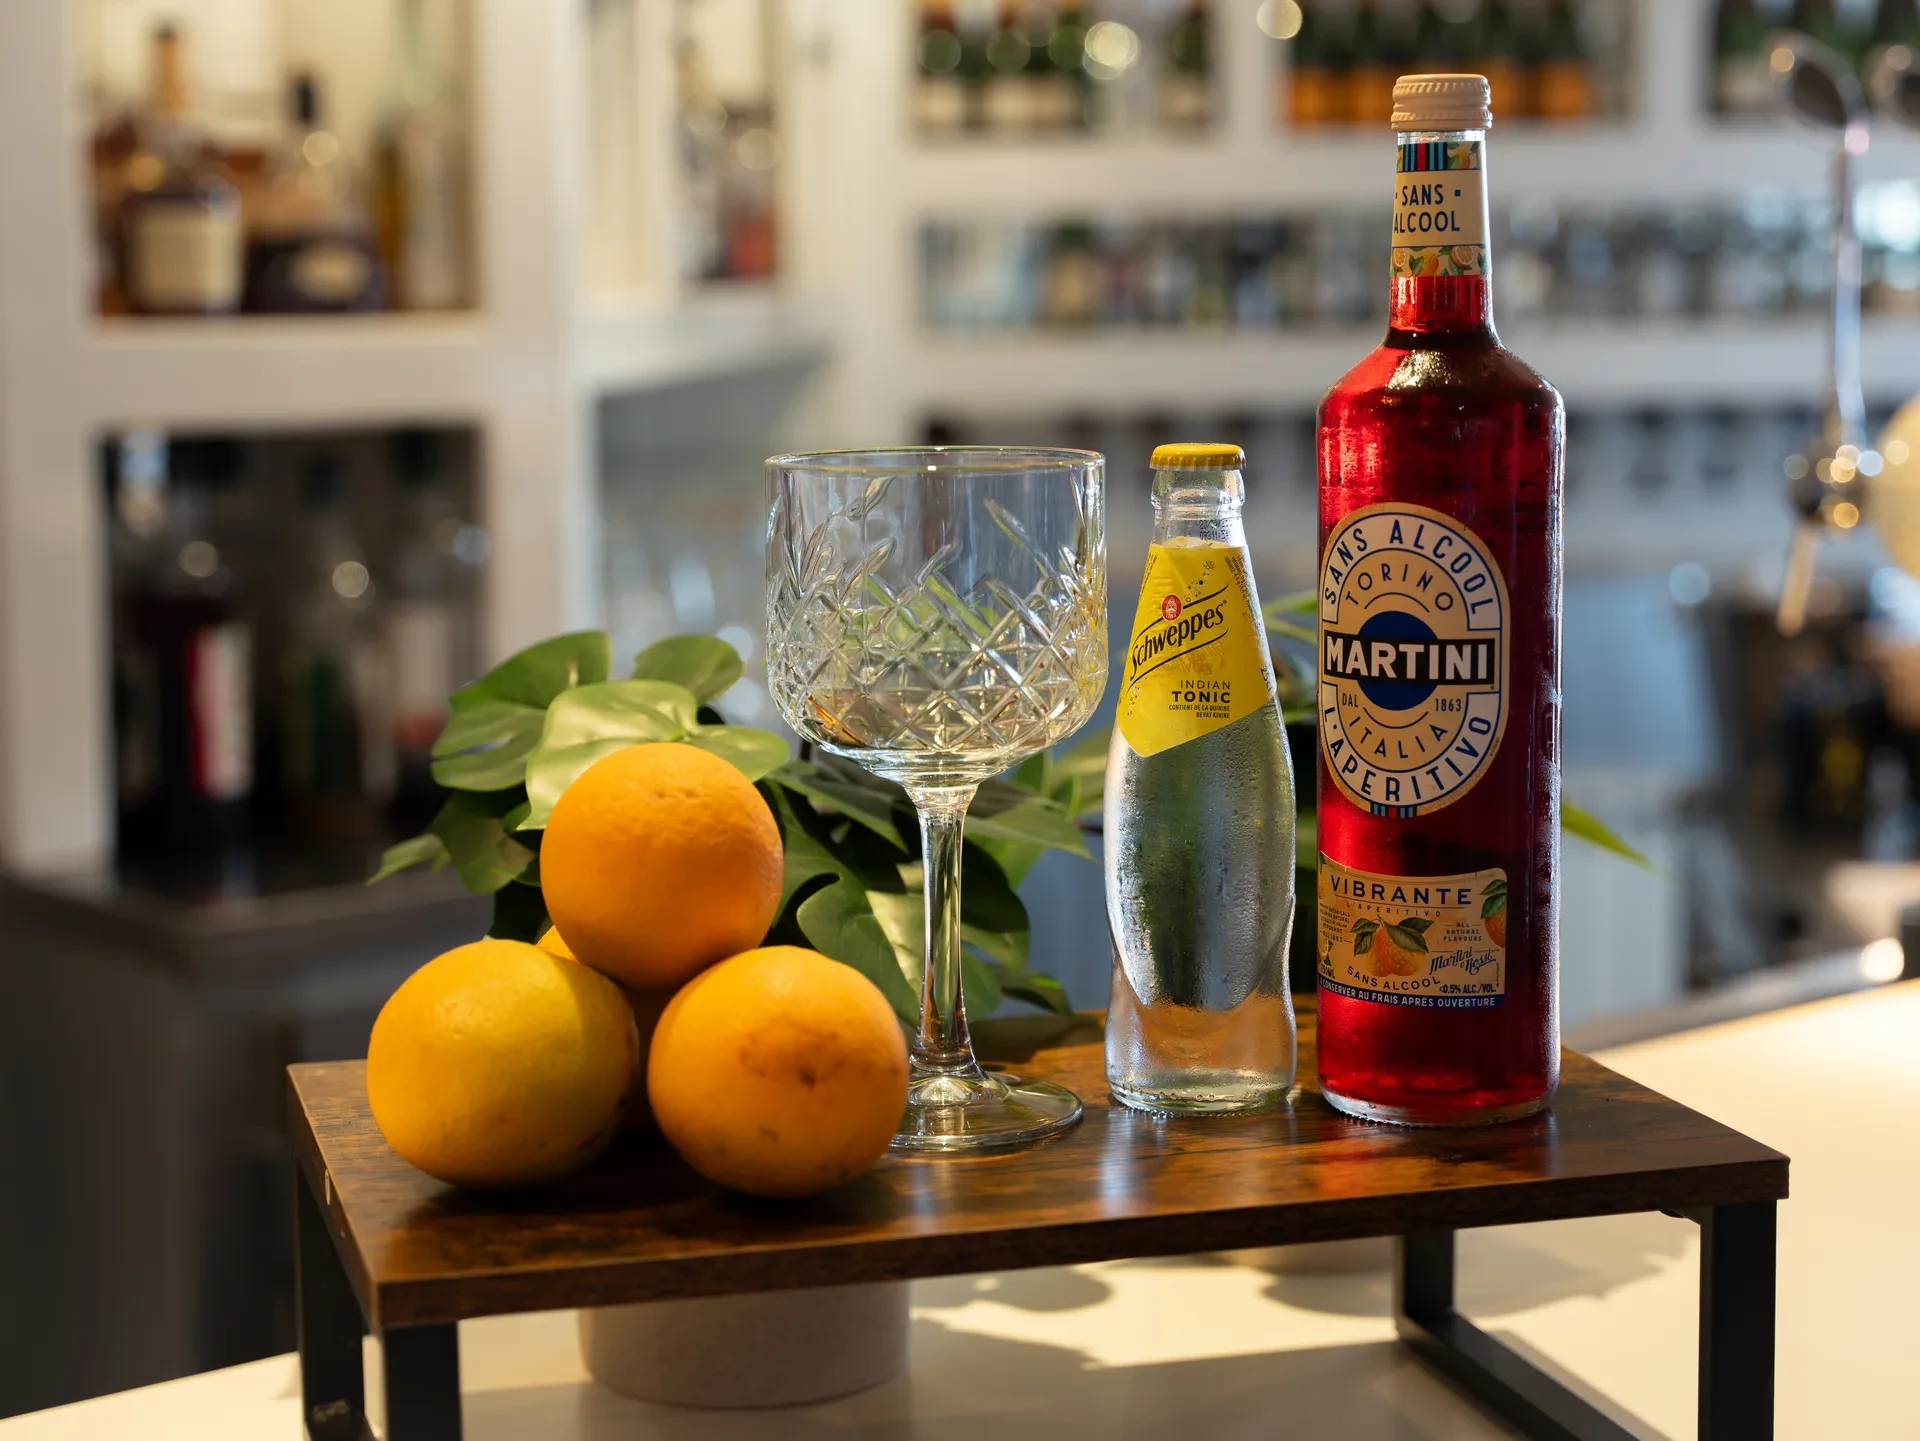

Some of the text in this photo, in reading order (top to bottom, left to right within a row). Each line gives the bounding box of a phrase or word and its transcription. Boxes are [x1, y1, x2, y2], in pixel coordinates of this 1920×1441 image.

[1402, 184, 1444, 206] SANS
[1394, 211, 1460, 234] ALCOOL
[1325, 528, 1368, 604] SANS
[1389, 519, 1493, 614] ALCOOL
[1345, 563, 1454, 611] TORINO
[1129, 602, 1225, 681] Schweppes
[1326, 635, 1488, 680] MARTINI
[1172, 691, 1231, 703] TONIC
[1180, 680, 1231, 690] INDIAN
[1342, 693, 1462, 712] DAL 1863
[1349, 716, 1448, 759] ITALIA
[1330, 875, 1472, 905] VIBRANTE
[1429, 946, 1473, 975] Martini
[1346, 966, 1441, 991] SANS ALCOOL
[1322, 979, 1356, 997] CONSERVER
[1358, 990, 1369, 1000] AU
[1371, 992, 1398, 1004] FRAIS
[1437, 998, 1496, 1007] OUVERTURE
